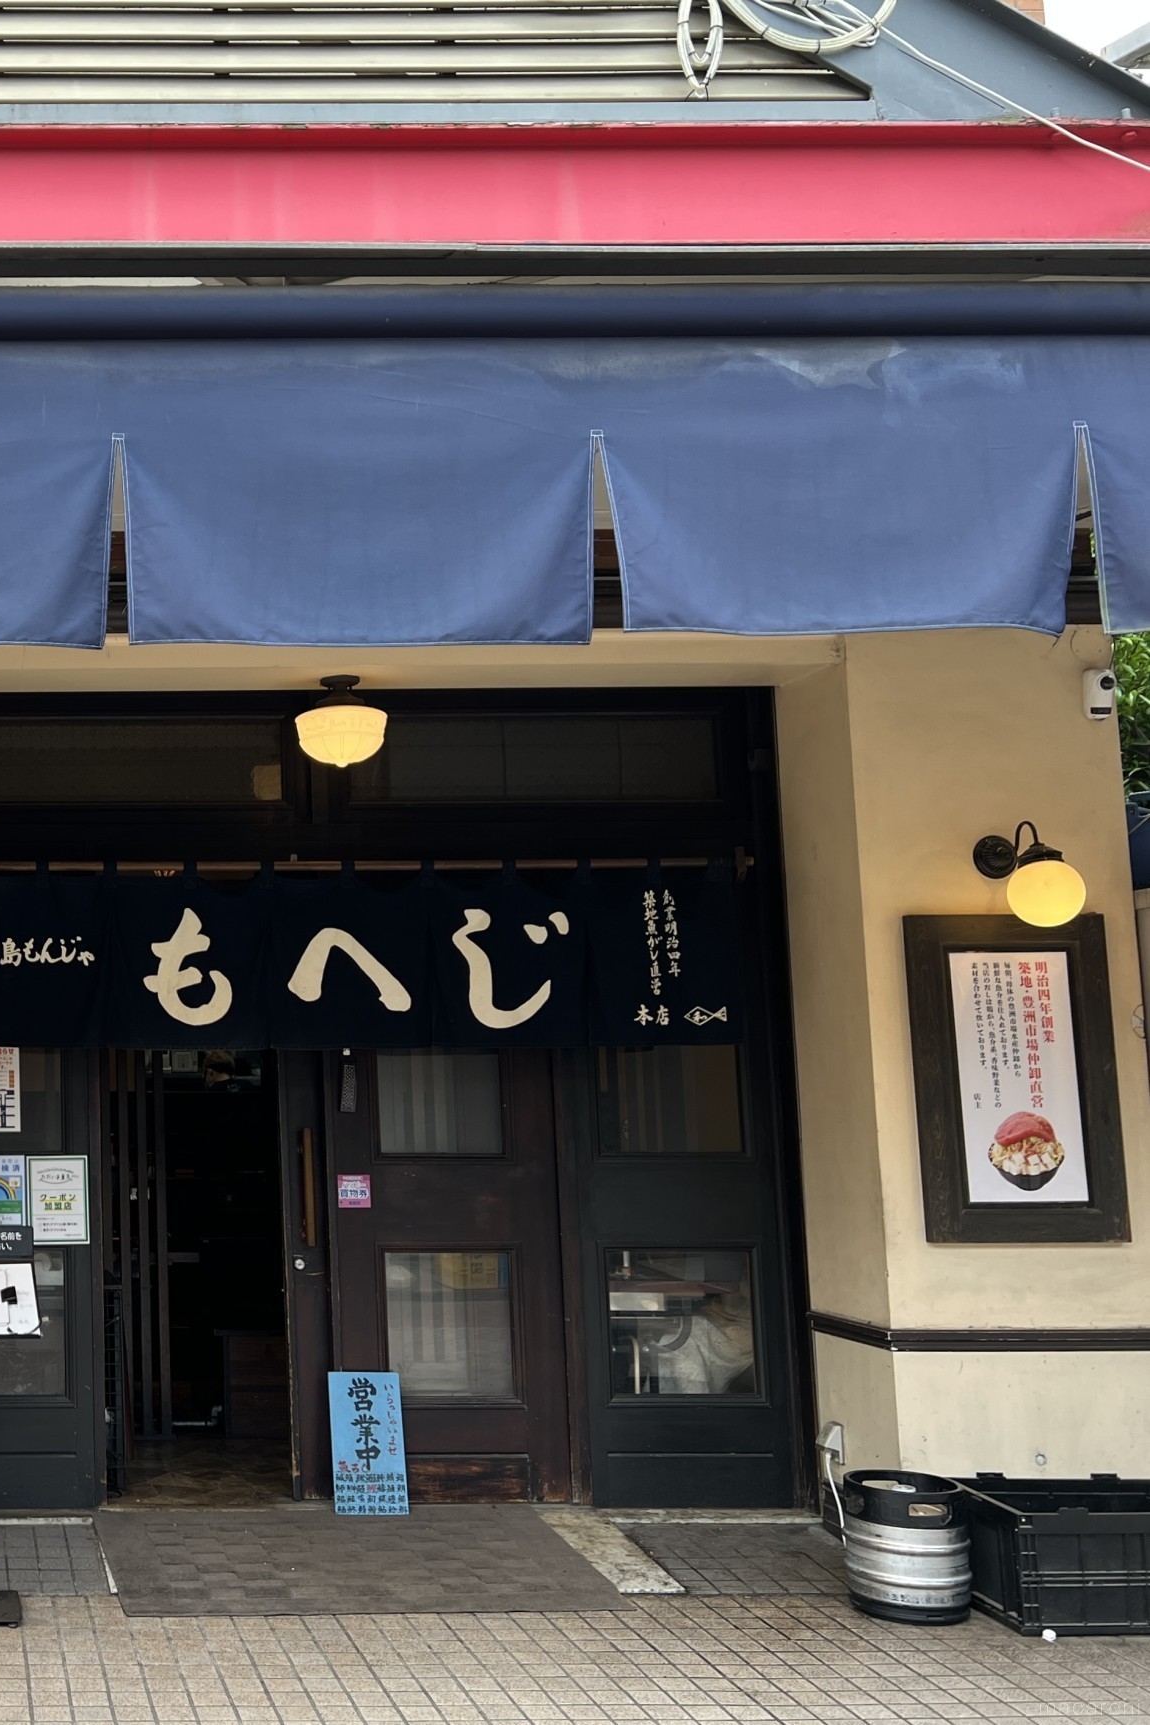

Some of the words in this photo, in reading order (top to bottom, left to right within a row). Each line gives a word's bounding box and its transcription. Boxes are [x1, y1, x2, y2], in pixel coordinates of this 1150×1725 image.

[143, 907, 570, 1028] もへじ
[642, 890, 663, 995] 築地魚がし直営
[662, 889, 681, 977] 創業明治四年
[634, 1004, 670, 1025] 本店
[1018, 962, 1044, 1108] 築地・豊洲市場仲卸直営
[1035, 961, 1056, 1043] 明治四年創業
[40, 1193, 76, 1202] クーポン
[44, 1202, 72, 1211] 加盟店
[339, 1188, 368, 1198] 買物券
[348, 1377, 381, 1470] 営業中
[383, 1384, 399, 1456] いらっしゃいませ
